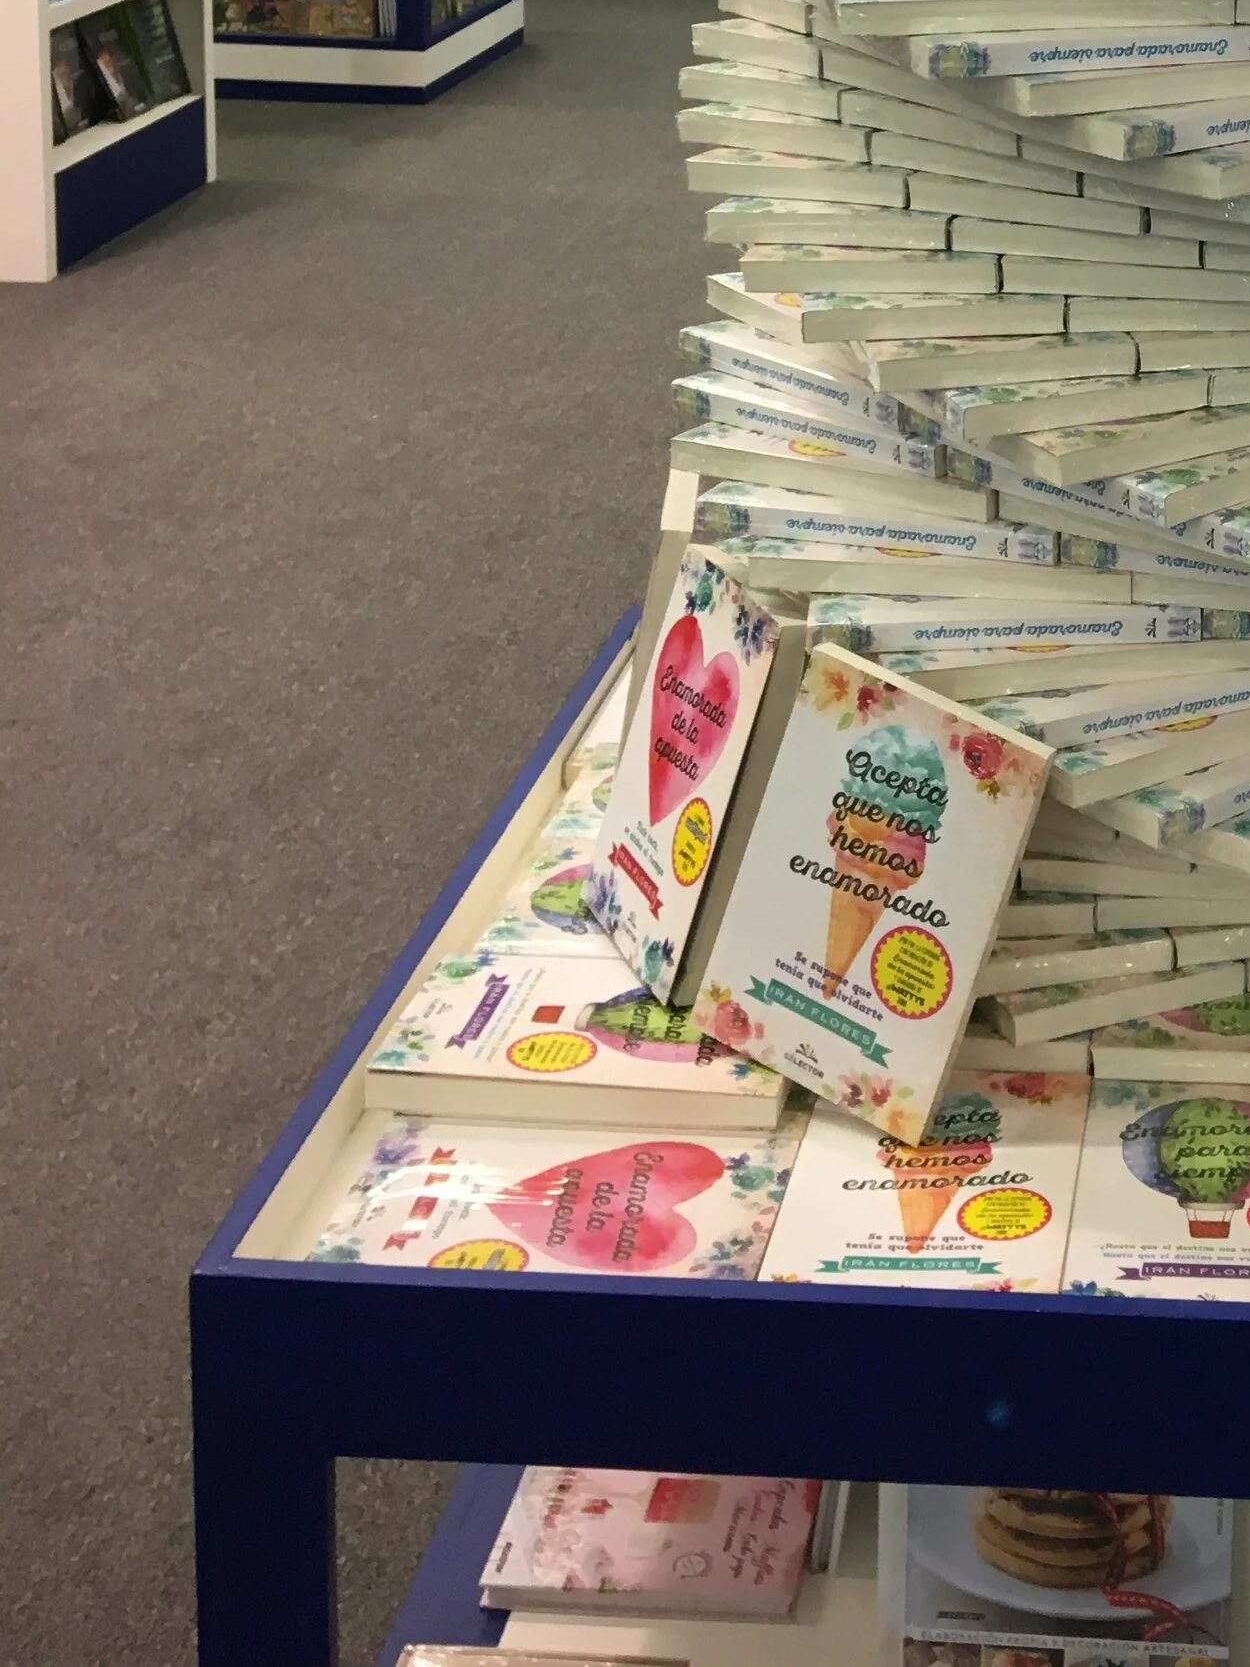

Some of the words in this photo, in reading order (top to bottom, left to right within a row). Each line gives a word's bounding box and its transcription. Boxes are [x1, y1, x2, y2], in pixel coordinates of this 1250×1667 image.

[1029, 45, 1092, 64] siempre
[1095, 42, 1135, 59] para
[1137, 40, 1227, 57] Enamorada
[786, 516, 843, 535] siempre
[849, 522, 886, 537] para
[887, 528, 976, 549] Enamorada
[913, 624, 979, 643] siempre
[983, 623, 1024, 638] para
[1026, 620, 1123, 638] Enamorada
[660, 664, 728, 730] Enamorada
[1146, 701, 1182, 721] para
[654, 736, 701, 782] apuesta
[846, 748, 950, 810] Acepta
[832, 791, 883, 828] que
[882, 812, 941, 845] nos
[828, 824, 924, 879] hemos
[789, 852, 950, 929] enamorado
[810, 960, 849, 987] supone
[852, 983, 873, 1000] que
[811, 1008, 872, 1047] FLORES
[884, 1153, 993, 1169] hemos
[842, 1169, 1034, 1191] enamorado
[613, 1150, 664, 1264] Enamorada
[898, 1258, 977, 1270] FLORES
